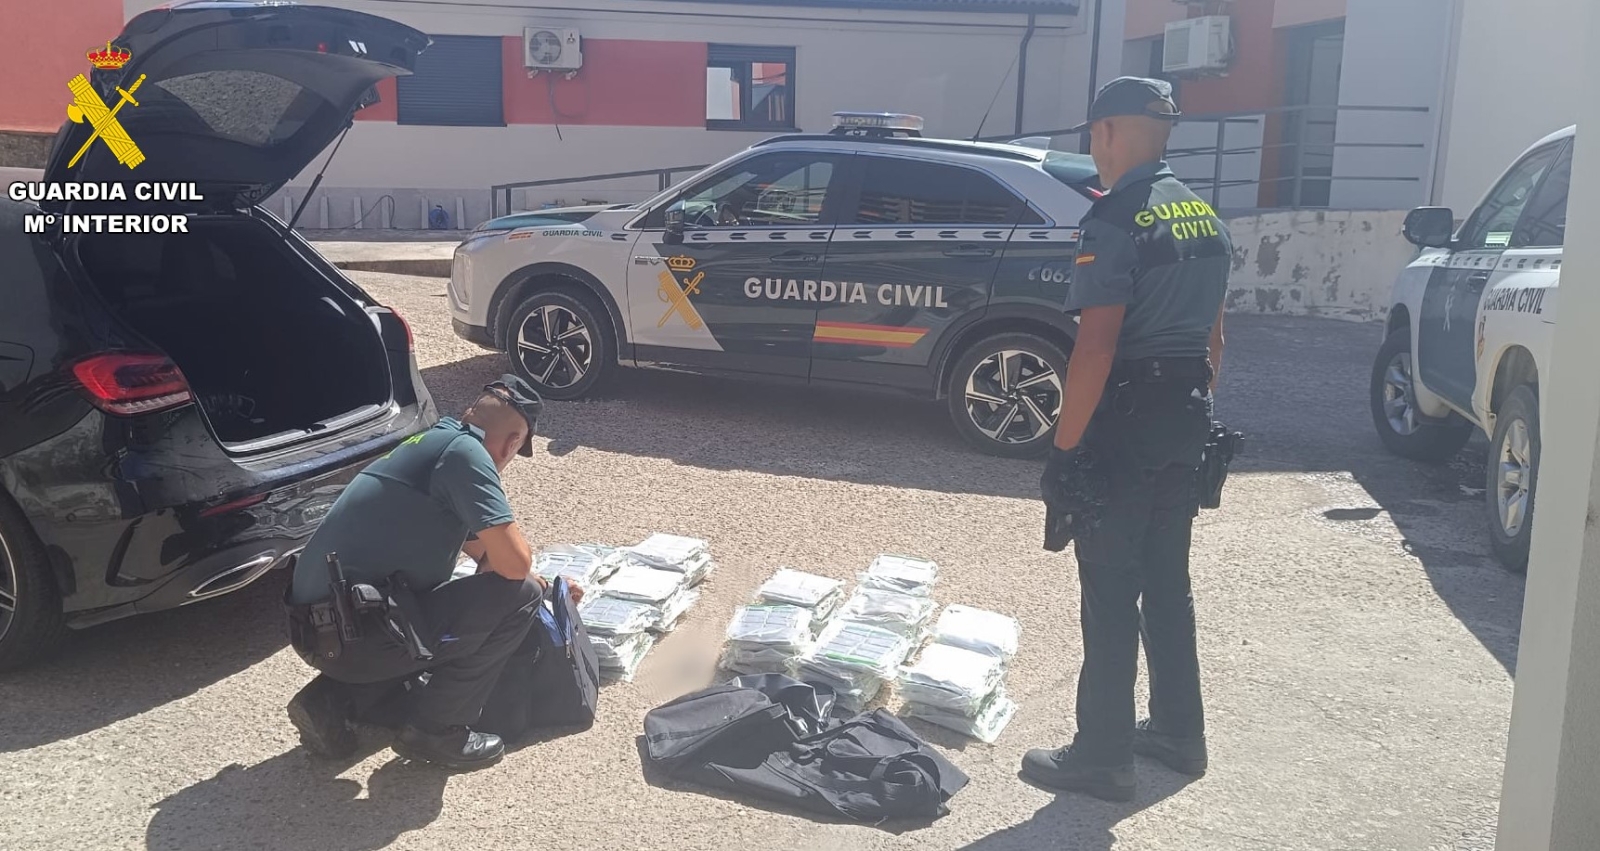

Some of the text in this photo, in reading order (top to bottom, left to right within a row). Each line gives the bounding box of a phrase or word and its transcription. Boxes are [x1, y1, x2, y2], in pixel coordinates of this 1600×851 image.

[542, 229, 604, 238] GUARDIA CIVIL
[1171, 219, 1218, 240] CIVIL
[743, 276, 948, 308] GUARDIA CIVIL
[1517, 287, 1546, 315] CIVIL
